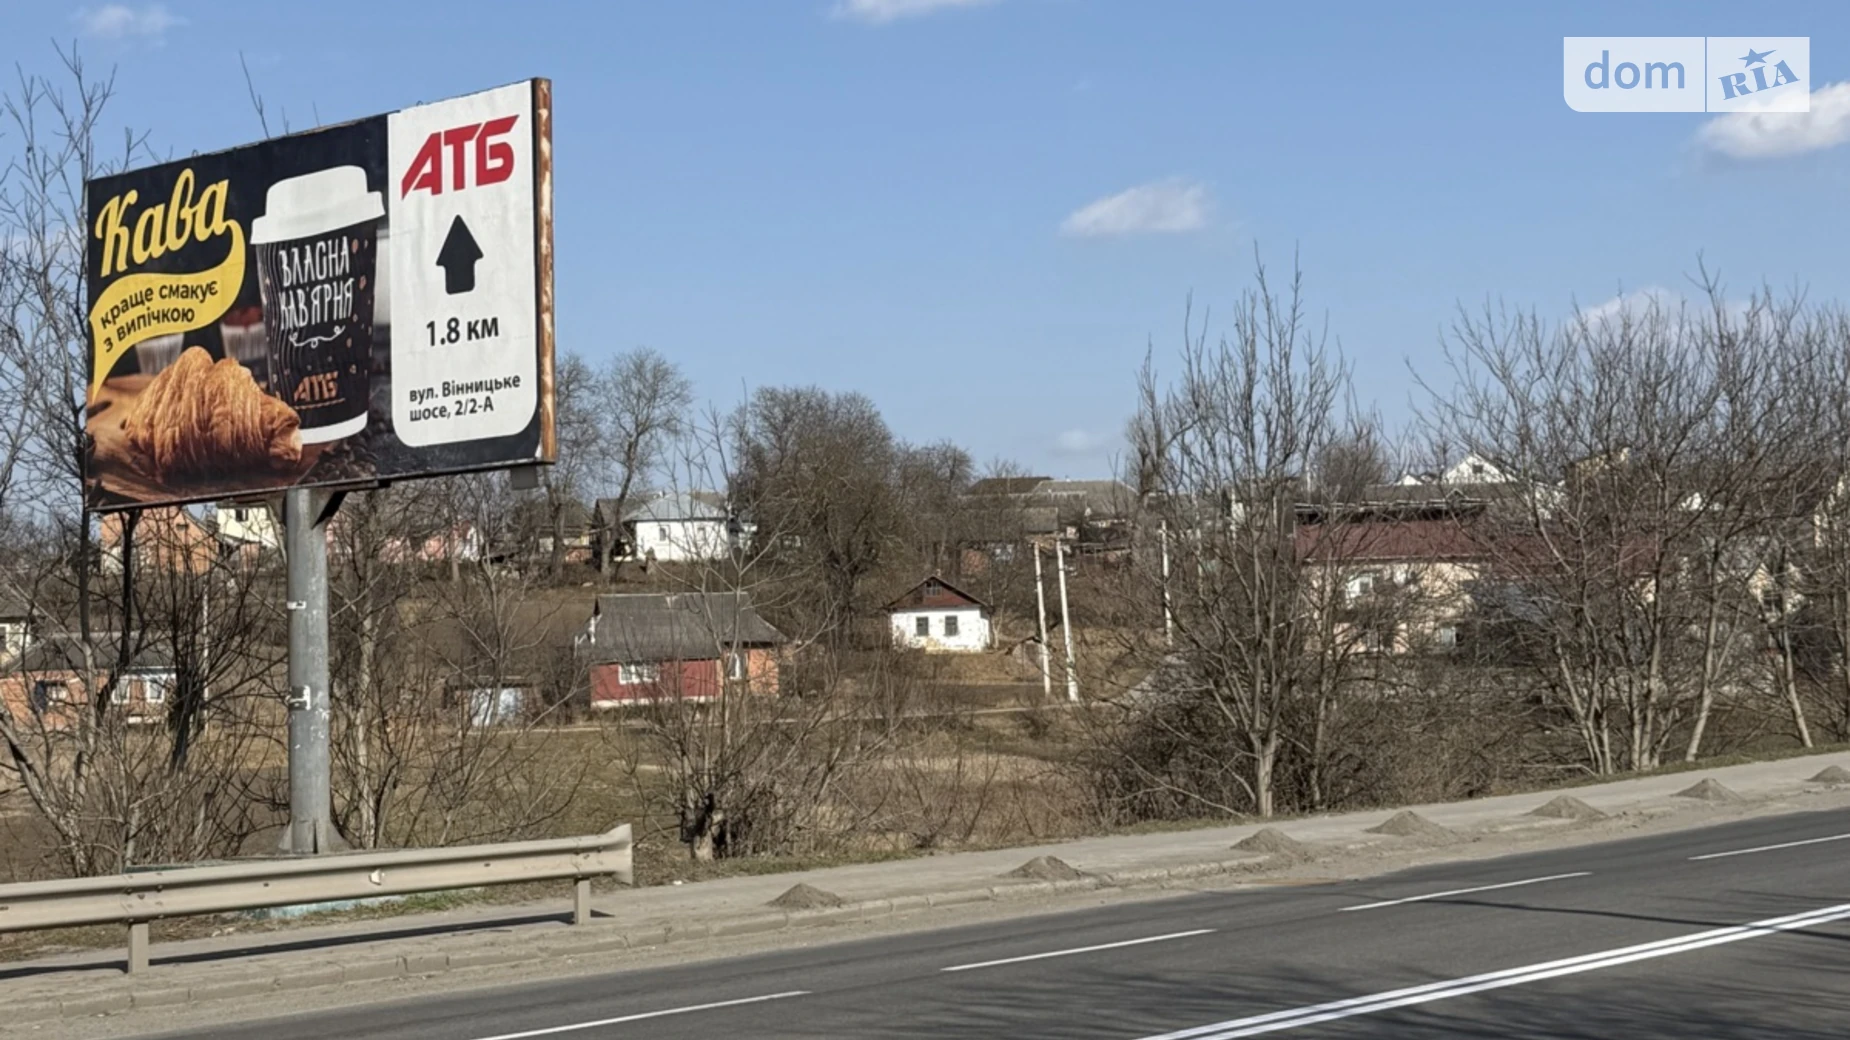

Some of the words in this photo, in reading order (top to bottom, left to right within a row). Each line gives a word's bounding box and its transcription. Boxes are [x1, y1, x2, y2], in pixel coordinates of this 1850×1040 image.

[401, 114, 520, 200] АТБ
[95, 168, 229, 278] Кава
[279, 236, 350, 287] ВЛАСНА
[100, 287, 154, 329] краще
[158, 280, 219, 303] смакує
[103, 337, 114, 353] з
[116, 306, 195, 342] випічкою
[426, 317, 461, 347] 1.8
[467, 317, 499, 341] км
[293, 370, 339, 402] АТБ
[409, 387, 439, 405] вул.
[442, 375, 521, 398] Вінницьке
[409, 405, 451, 422] шосе,
[455, 395, 494, 416] 2/2-А
